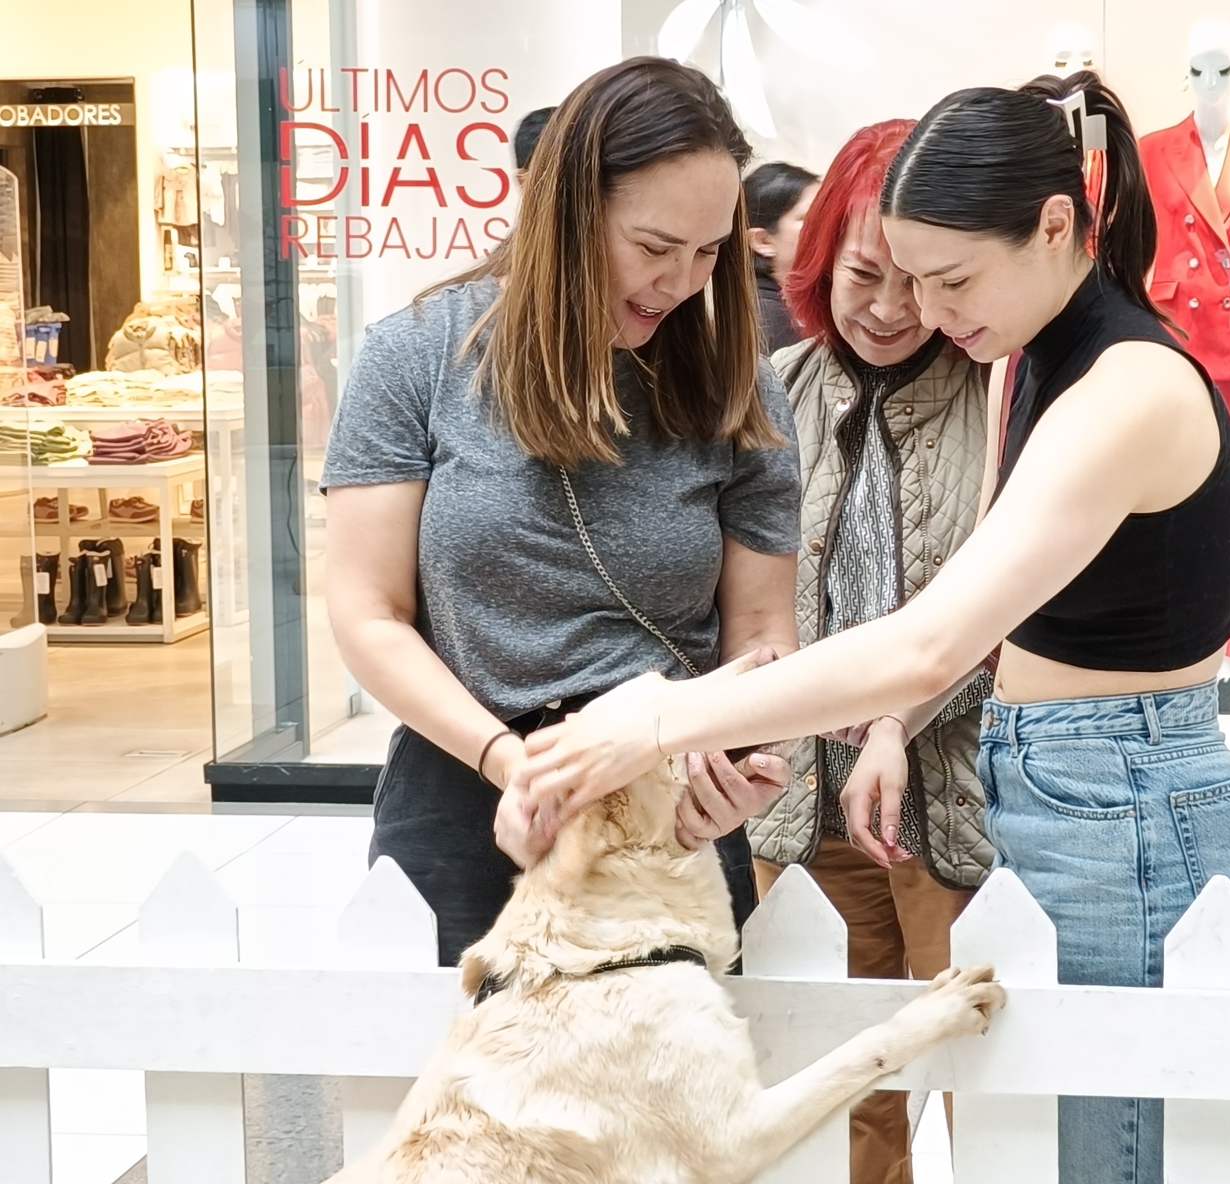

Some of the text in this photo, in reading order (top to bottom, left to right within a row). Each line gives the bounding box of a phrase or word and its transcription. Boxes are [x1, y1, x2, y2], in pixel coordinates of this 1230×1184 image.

[279, 59, 509, 114] ÚLTIMOS
[0, 104, 122, 127] OBADORES
[280, 113, 510, 209] DÍAS
